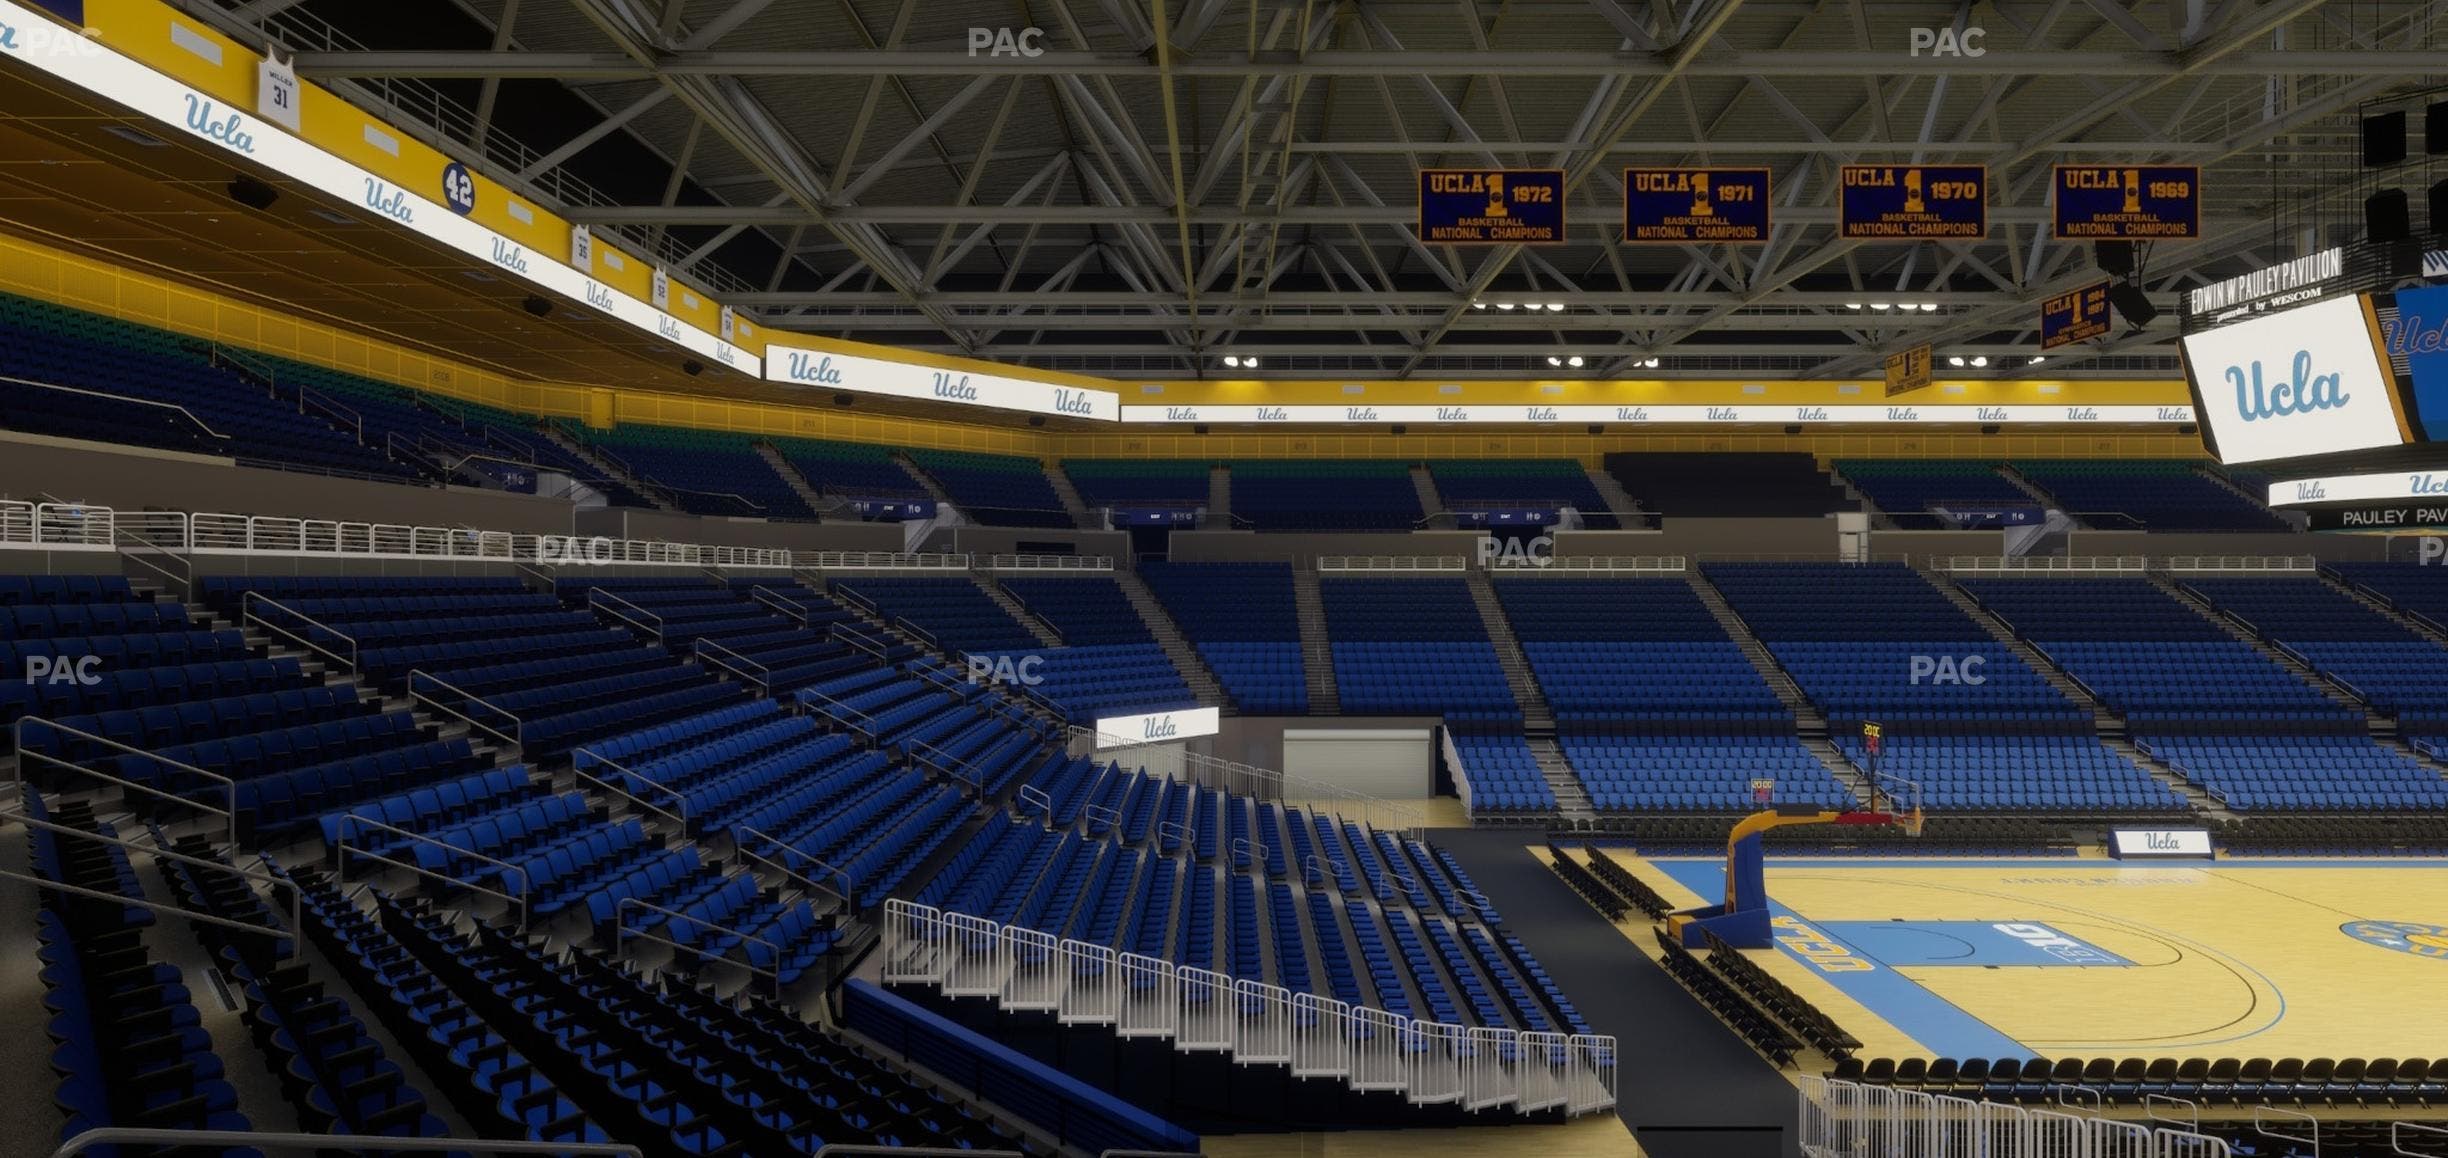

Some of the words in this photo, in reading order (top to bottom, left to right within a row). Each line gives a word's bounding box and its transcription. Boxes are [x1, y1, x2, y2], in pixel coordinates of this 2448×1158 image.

[269, 71, 293, 88] MILLER
[274, 85, 288, 109] 31
[185, 93, 254, 153] Ucla
[1430, 174, 1485, 192] UCLA
[1636, 173, 1690, 192] UCLA
[1845, 169, 1895, 187] UCLA
[2065, 170, 2119, 188] UCLA
[446, 169, 472, 207] 42
[1512, 186, 1552, 202] 1972
[1718, 186, 1753, 202] 1971
[1930, 182, 1977, 199] 1970
[2149, 182, 2189, 198] 1969
[365, 178, 413, 223] Ucla
[1458, 218, 1525, 226] BASKETBALL
[1663, 217, 1730, 225] BASKETBALL
[1882, 213, 1941, 222] BASKETBALL
[2093, 214, 2160, 222] BASKETBALL
[1431, 227, 1482, 239] NATIONAL
[1490, 227, 1552, 239] CHAMPIONS
[1637, 226, 1687, 238] NATIONAL
[1696, 226, 1758, 238] CHAMPIONS
[1850, 222, 1905, 235] NATIONAL
[1908, 222, 1978, 235] CHAMPIONS
[2066, 223, 2117, 235] NATIONAL
[2125, 223, 2187, 235] CHAMPIONS
[492, 236, 527, 273] Ucla
[2191, 281, 2224, 315] EDWIN
[2226, 277, 2237, 306] W
[2239, 265, 2280, 302] PAULEY
[2282, 246, 2342, 291] PAVILION
[586, 280, 614, 312] Ucla
[2046, 296, 2071, 315] UCLA
[2256, 301, 2266, 311] by
[2271, 287, 2321, 307] WESCOM
[659, 315, 680, 341] Ucla
[717, 342, 734, 366] Ucla
[789, 352, 841, 384] Ucla
[933, 371, 977, 401] Ucla
[2225, 350, 2350, 422] Ucla
[1054, 388, 1092, 415] Ucla
[1167, 407, 1198, 421] Ucla
[1257, 407, 1288, 421] Ucla
[1347, 407, 1378, 421] Ucla
[1437, 407, 1468, 421] Ucla
[1527, 407, 1558, 421] Ucla
[1617, 407, 1648, 421] Ucla
[1707, 407, 1738, 421] Ucla
[1797, 407, 1828, 421] Ucla
[1887, 407, 1918, 421] Ucla
[1977, 407, 2008, 421] Ucla
[2067, 407, 2098, 421] Ucla
[2157, 407, 2188, 421] Ucla
[2297, 482, 2326, 501] Ucla
[2343, 510, 2408, 525] PAULEY
[1144, 715, 1177, 738] Ucla
[2145, 832, 2181, 851] Ucla
